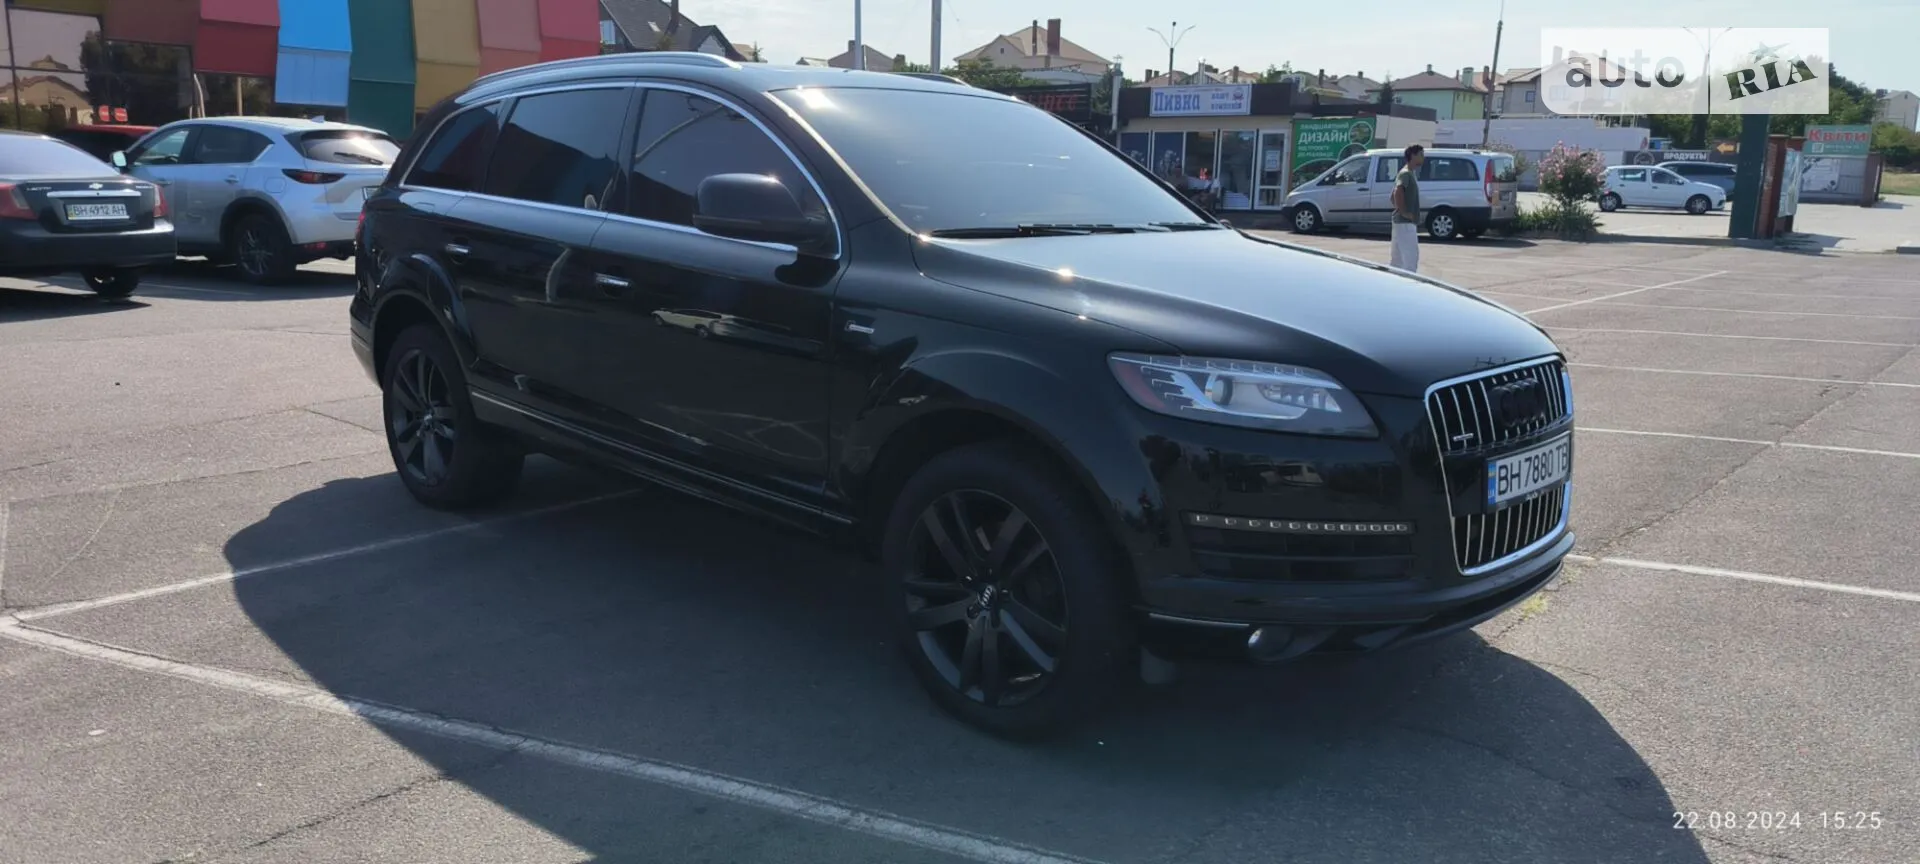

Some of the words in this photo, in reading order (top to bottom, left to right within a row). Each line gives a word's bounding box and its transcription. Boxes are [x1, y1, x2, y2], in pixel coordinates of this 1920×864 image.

[1298, 130, 1348, 144] ДИЗАЙН
[1809, 129, 1868, 142] Квіти
[1524, 449, 1554, 488] 7880
